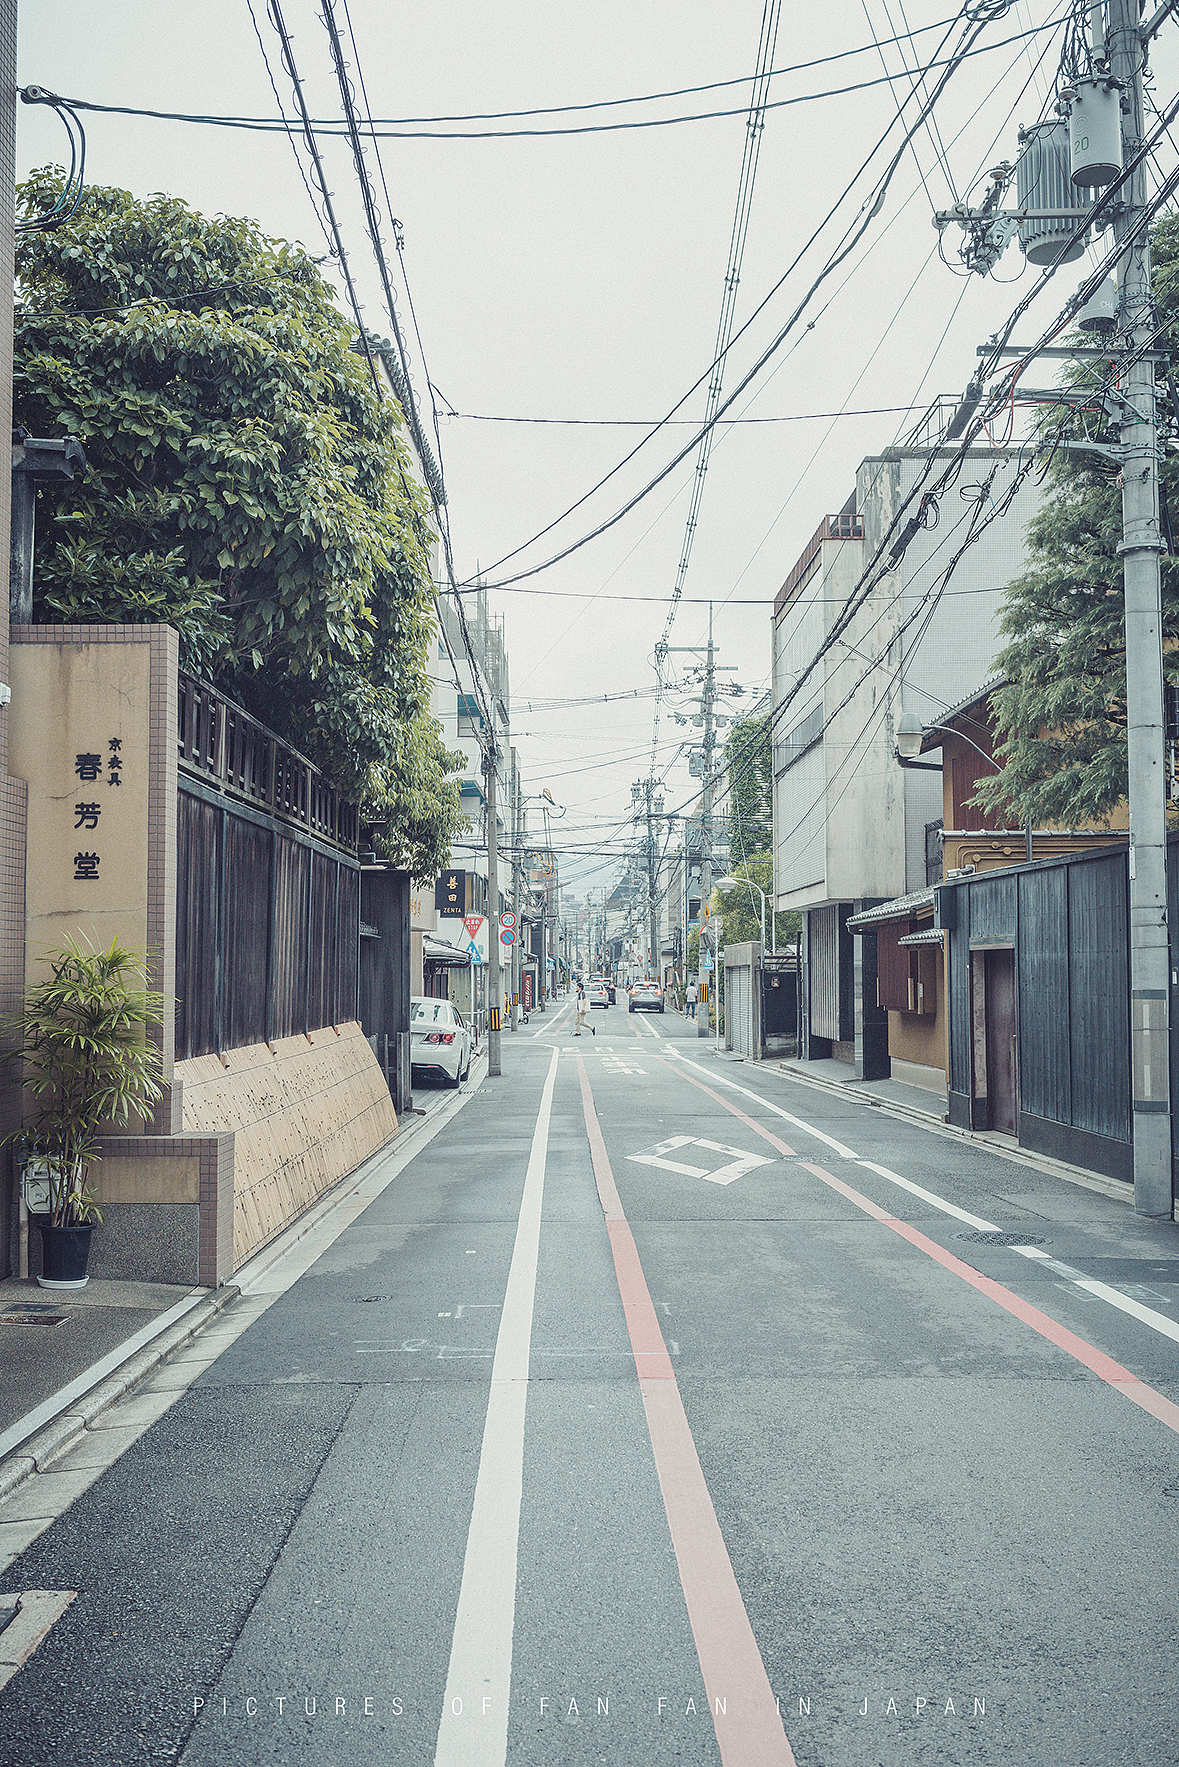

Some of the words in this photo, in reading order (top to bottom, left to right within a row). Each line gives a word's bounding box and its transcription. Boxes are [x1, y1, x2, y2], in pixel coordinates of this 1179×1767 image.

[1073, 136, 1089, 155] 20
[107, 737, 123, 787] 京表具
[73, 752, 103, 880] 春芳堂
[503, 916, 513, 924] 20
